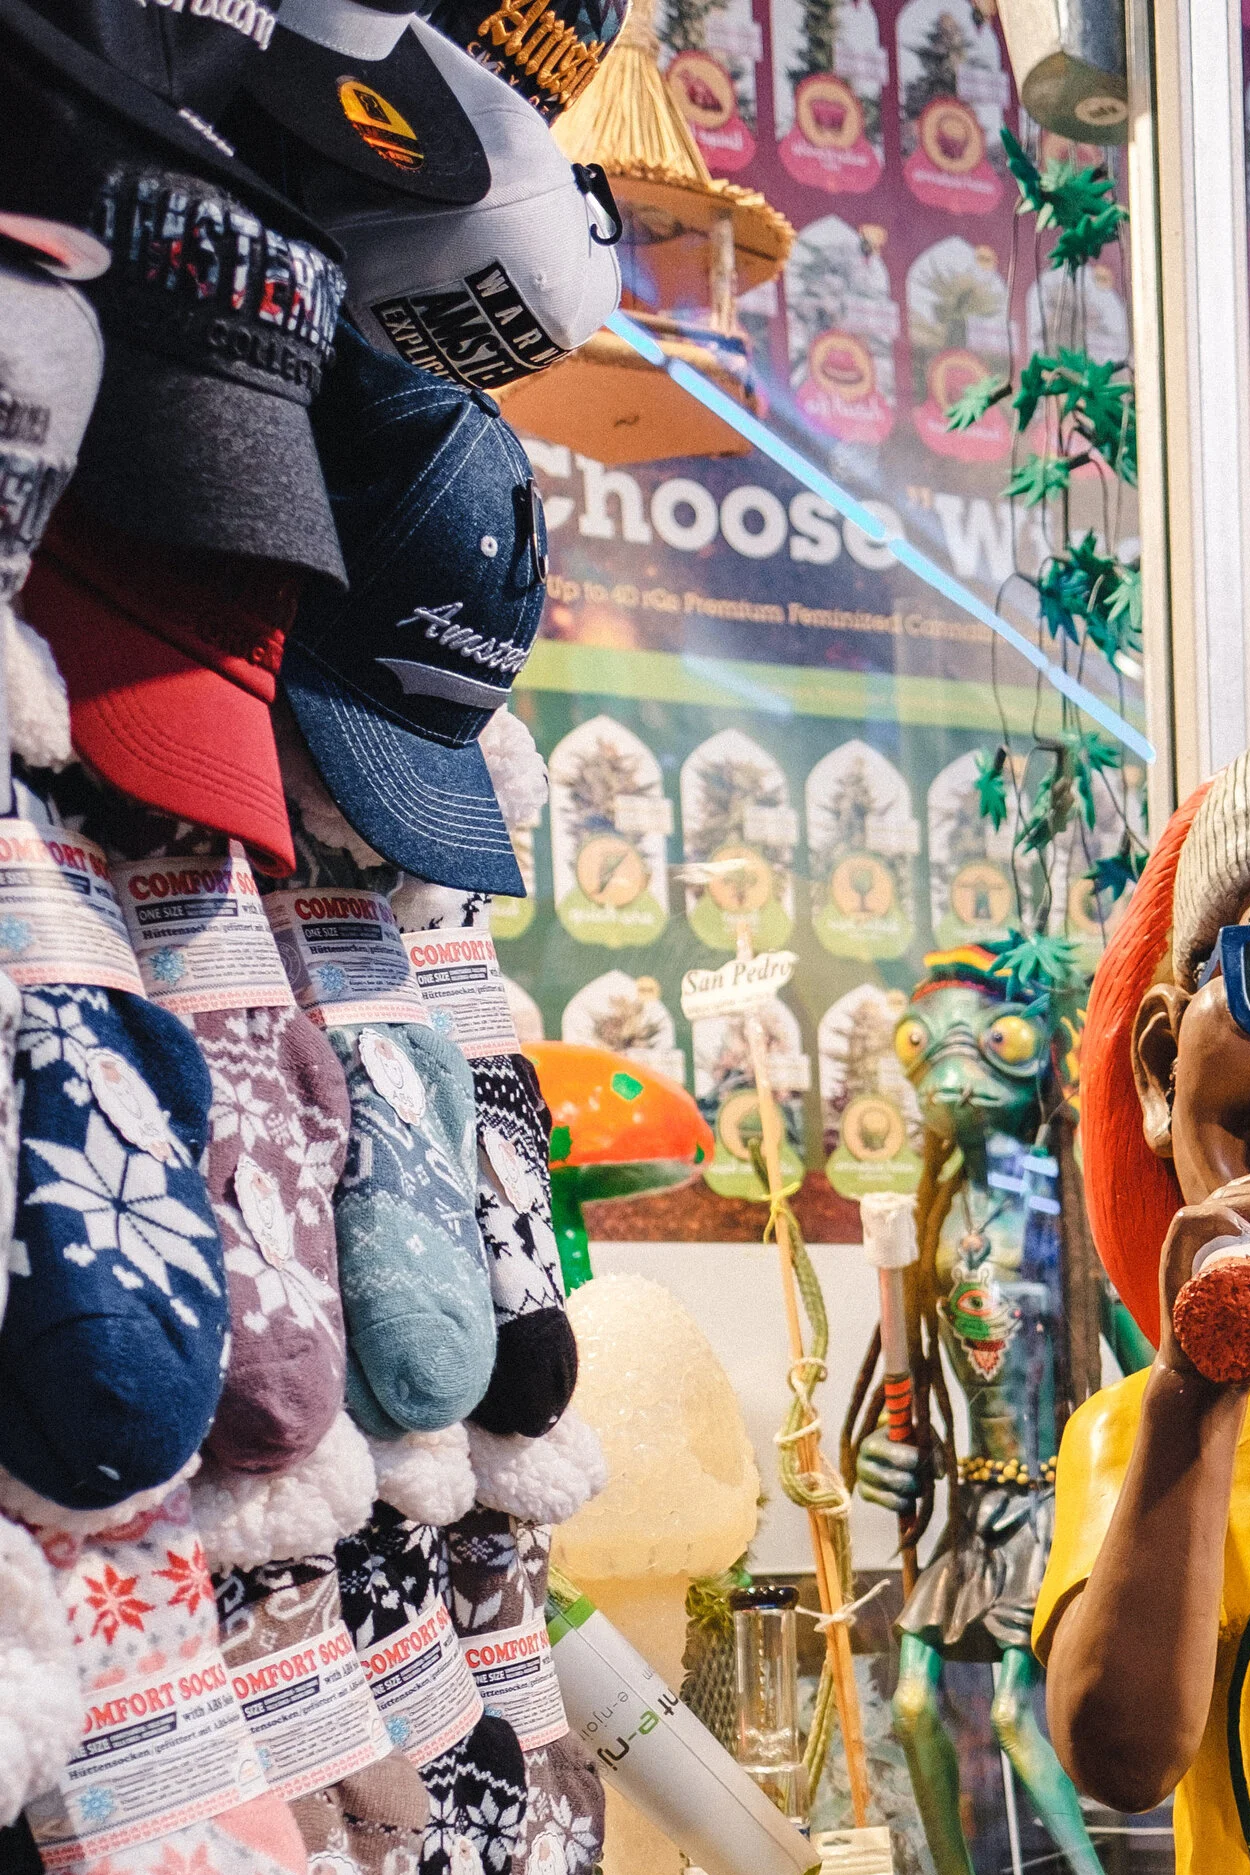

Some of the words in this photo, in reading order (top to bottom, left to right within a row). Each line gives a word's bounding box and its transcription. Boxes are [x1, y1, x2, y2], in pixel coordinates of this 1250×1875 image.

[523, 438, 902, 571] Choose
[0, 836, 87, 872] OMFORT
[128, 869, 237, 900] COMFORT
[139, 907, 161, 922] ONE
[163, 904, 184, 918] SIZE
[294, 897, 380, 921] COMFORT
[305, 928, 321, 938] ONE
[322, 927, 339, 938] SIZE
[410, 940, 486, 968] COMFORT
[418, 975, 434, 985] ONE
[435, 971, 450, 982] SIZE
[684, 970, 724, 996] San
[732, 957, 793, 986] Pedro
[360, 1617, 438, 1681] COMFORT
[465, 1632, 540, 1669] COMFORT
[178, 1663, 227, 1700] SOCKS
[231, 1649, 318, 1700] OMFORT
[385, 1675, 401, 1688] SIZE
[489, 1670, 506, 1681] SIZE
[480, 1681, 528, 1699] üttensocken
[251, 1710, 299, 1734] tensocken
